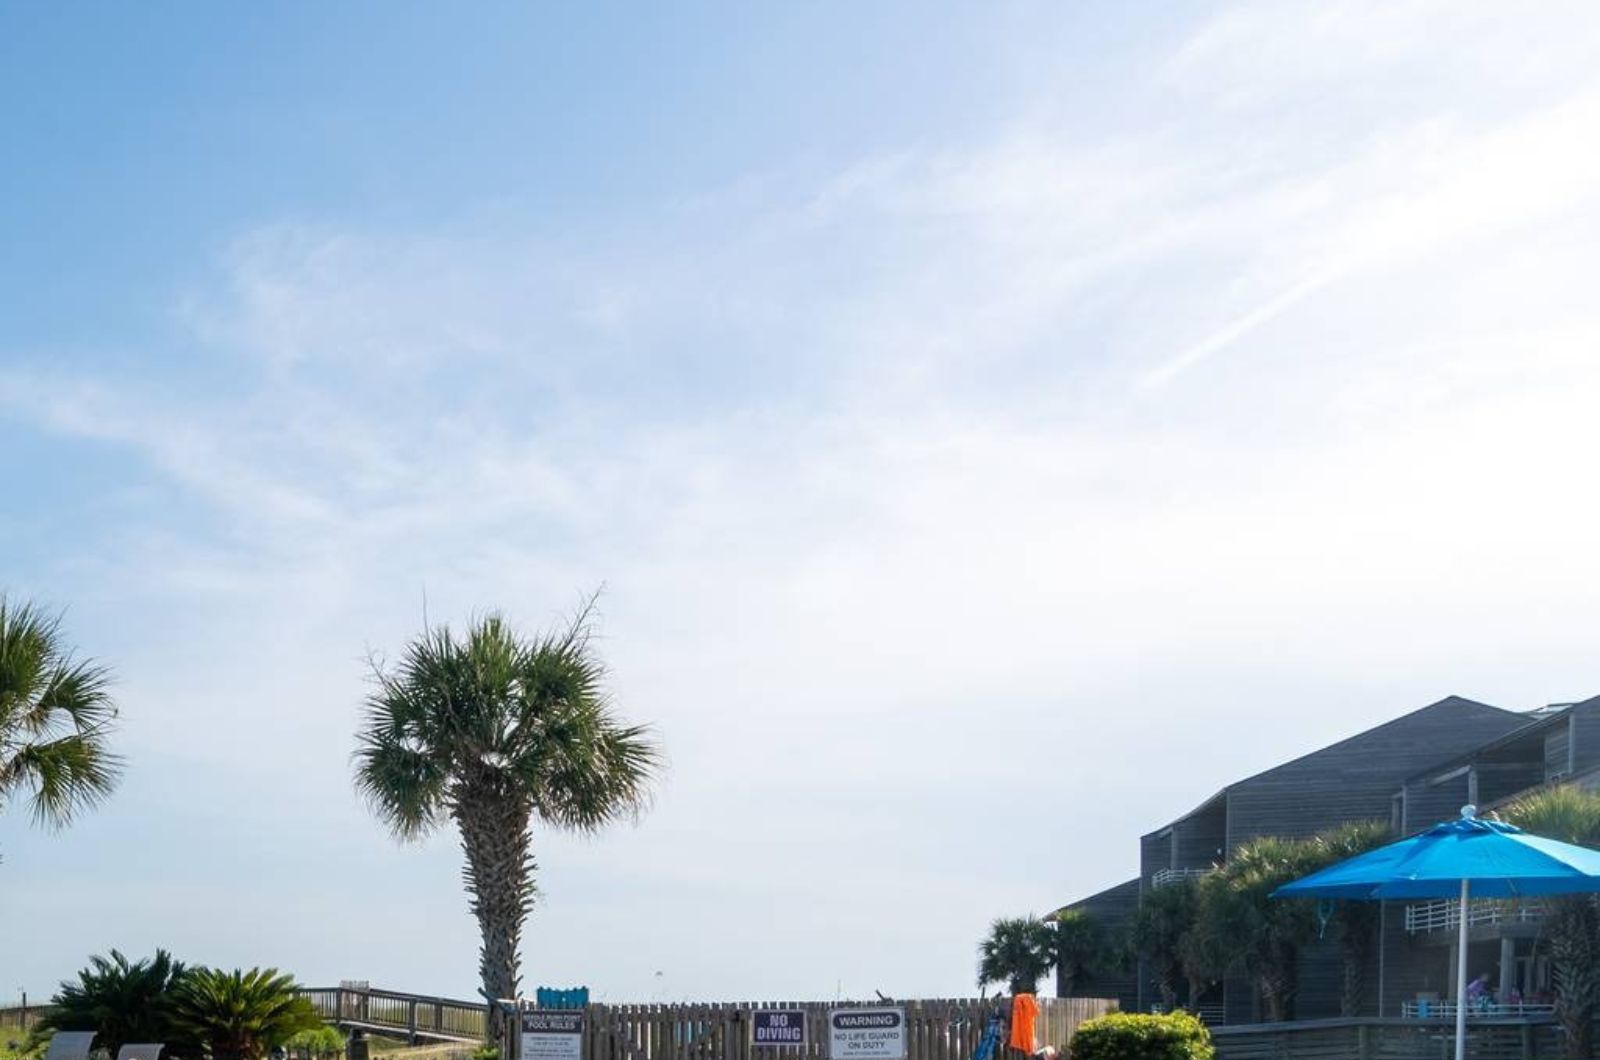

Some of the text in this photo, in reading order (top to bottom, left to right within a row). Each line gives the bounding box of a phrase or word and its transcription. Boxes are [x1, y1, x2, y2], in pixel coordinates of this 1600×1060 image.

[528, 1021, 575, 1030] POOL RULES
[770, 1014, 788, 1027] NO
[839, 1015, 893, 1026] WARNING
[757, 1027, 801, 1040] DIVING
[848, 1032, 866, 1040] LIFE
[868, 1032, 900, 1040] GUARD
[847, 1041, 885, 1049] ON DUTY
